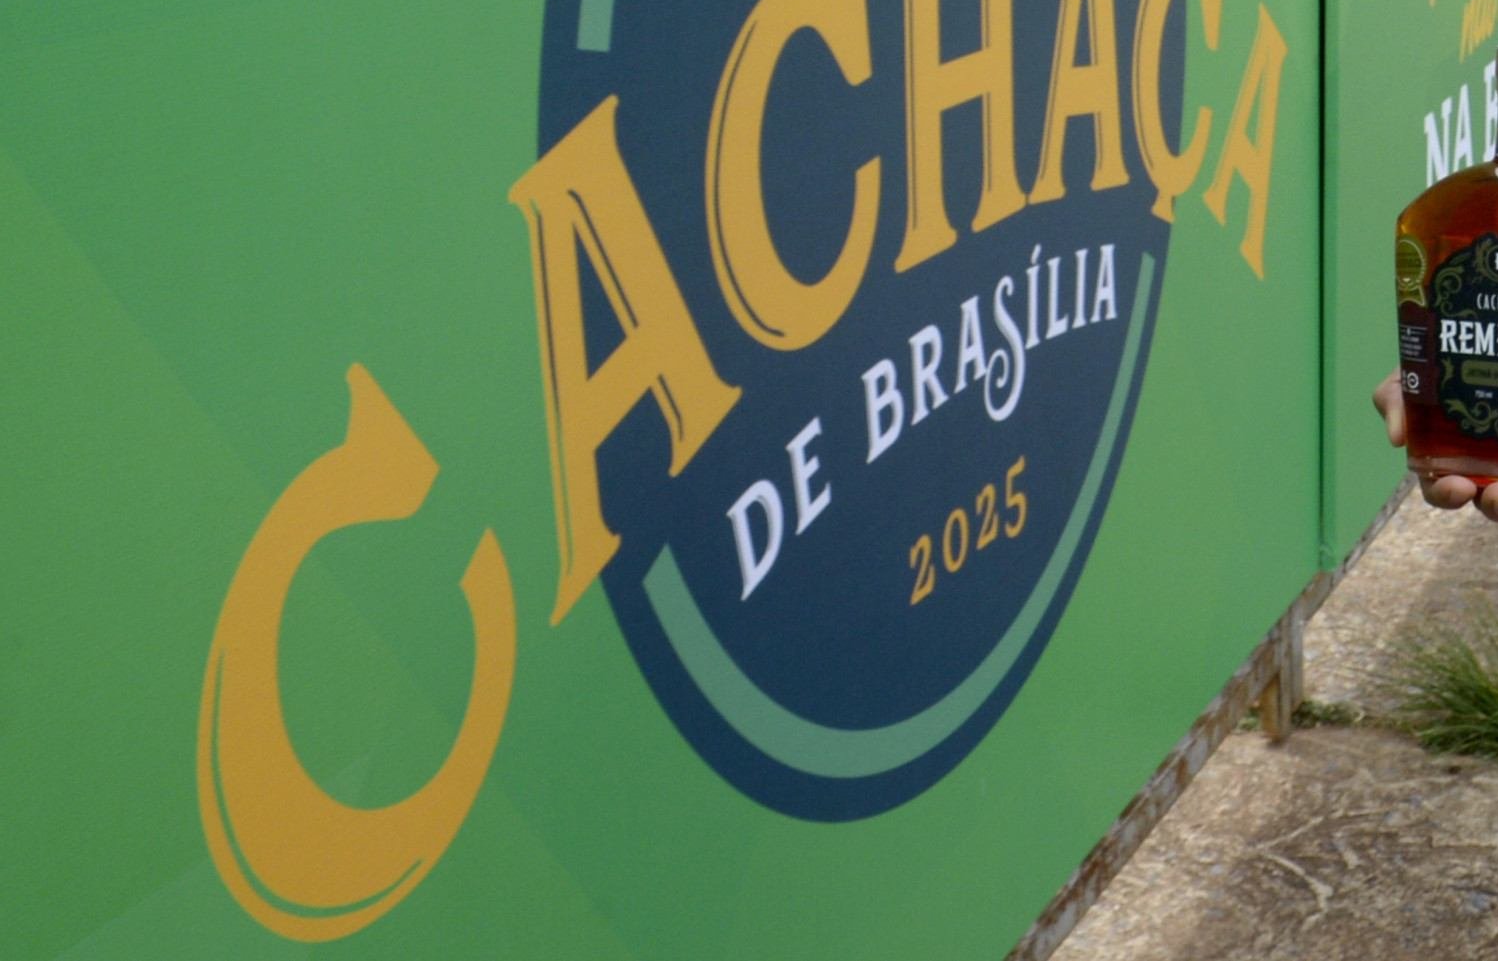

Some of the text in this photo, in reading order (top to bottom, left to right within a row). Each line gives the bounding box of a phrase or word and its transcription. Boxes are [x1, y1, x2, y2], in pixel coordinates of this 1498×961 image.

[1424, 83, 1474, 188] NA
[726, 243, 1118, 602] DE BRASÍLIA
[909, 455, 1027, 606] 2025
